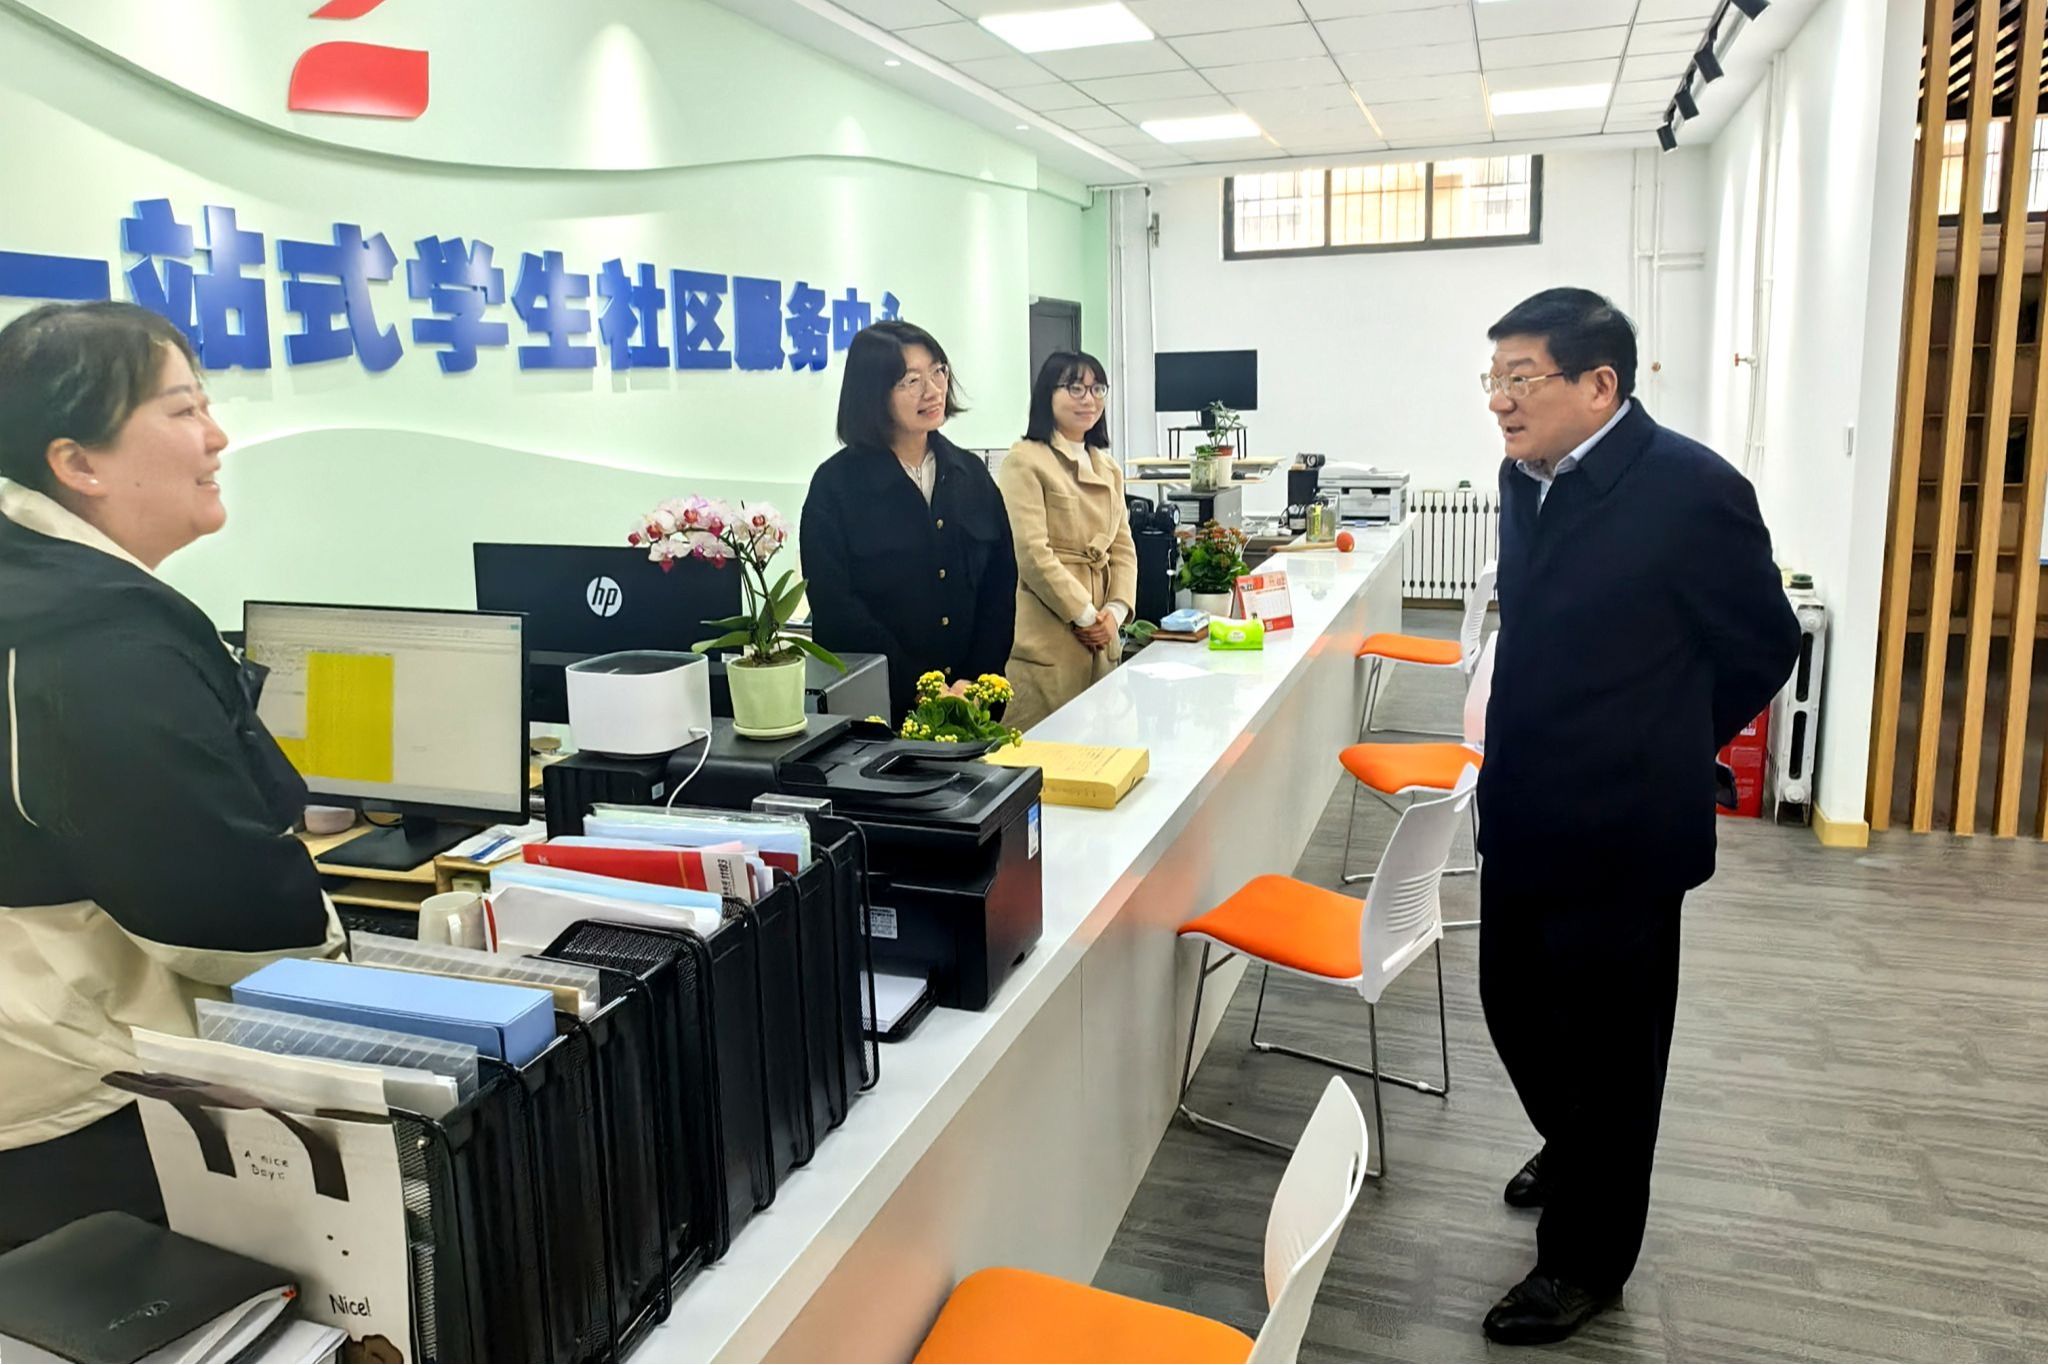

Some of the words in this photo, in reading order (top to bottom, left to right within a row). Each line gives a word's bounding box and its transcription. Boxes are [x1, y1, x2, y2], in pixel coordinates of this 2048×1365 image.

[591, 577, 619, 617] hp
[244, 1150, 251, 1158] A
[261, 1155, 289, 1168] nice
